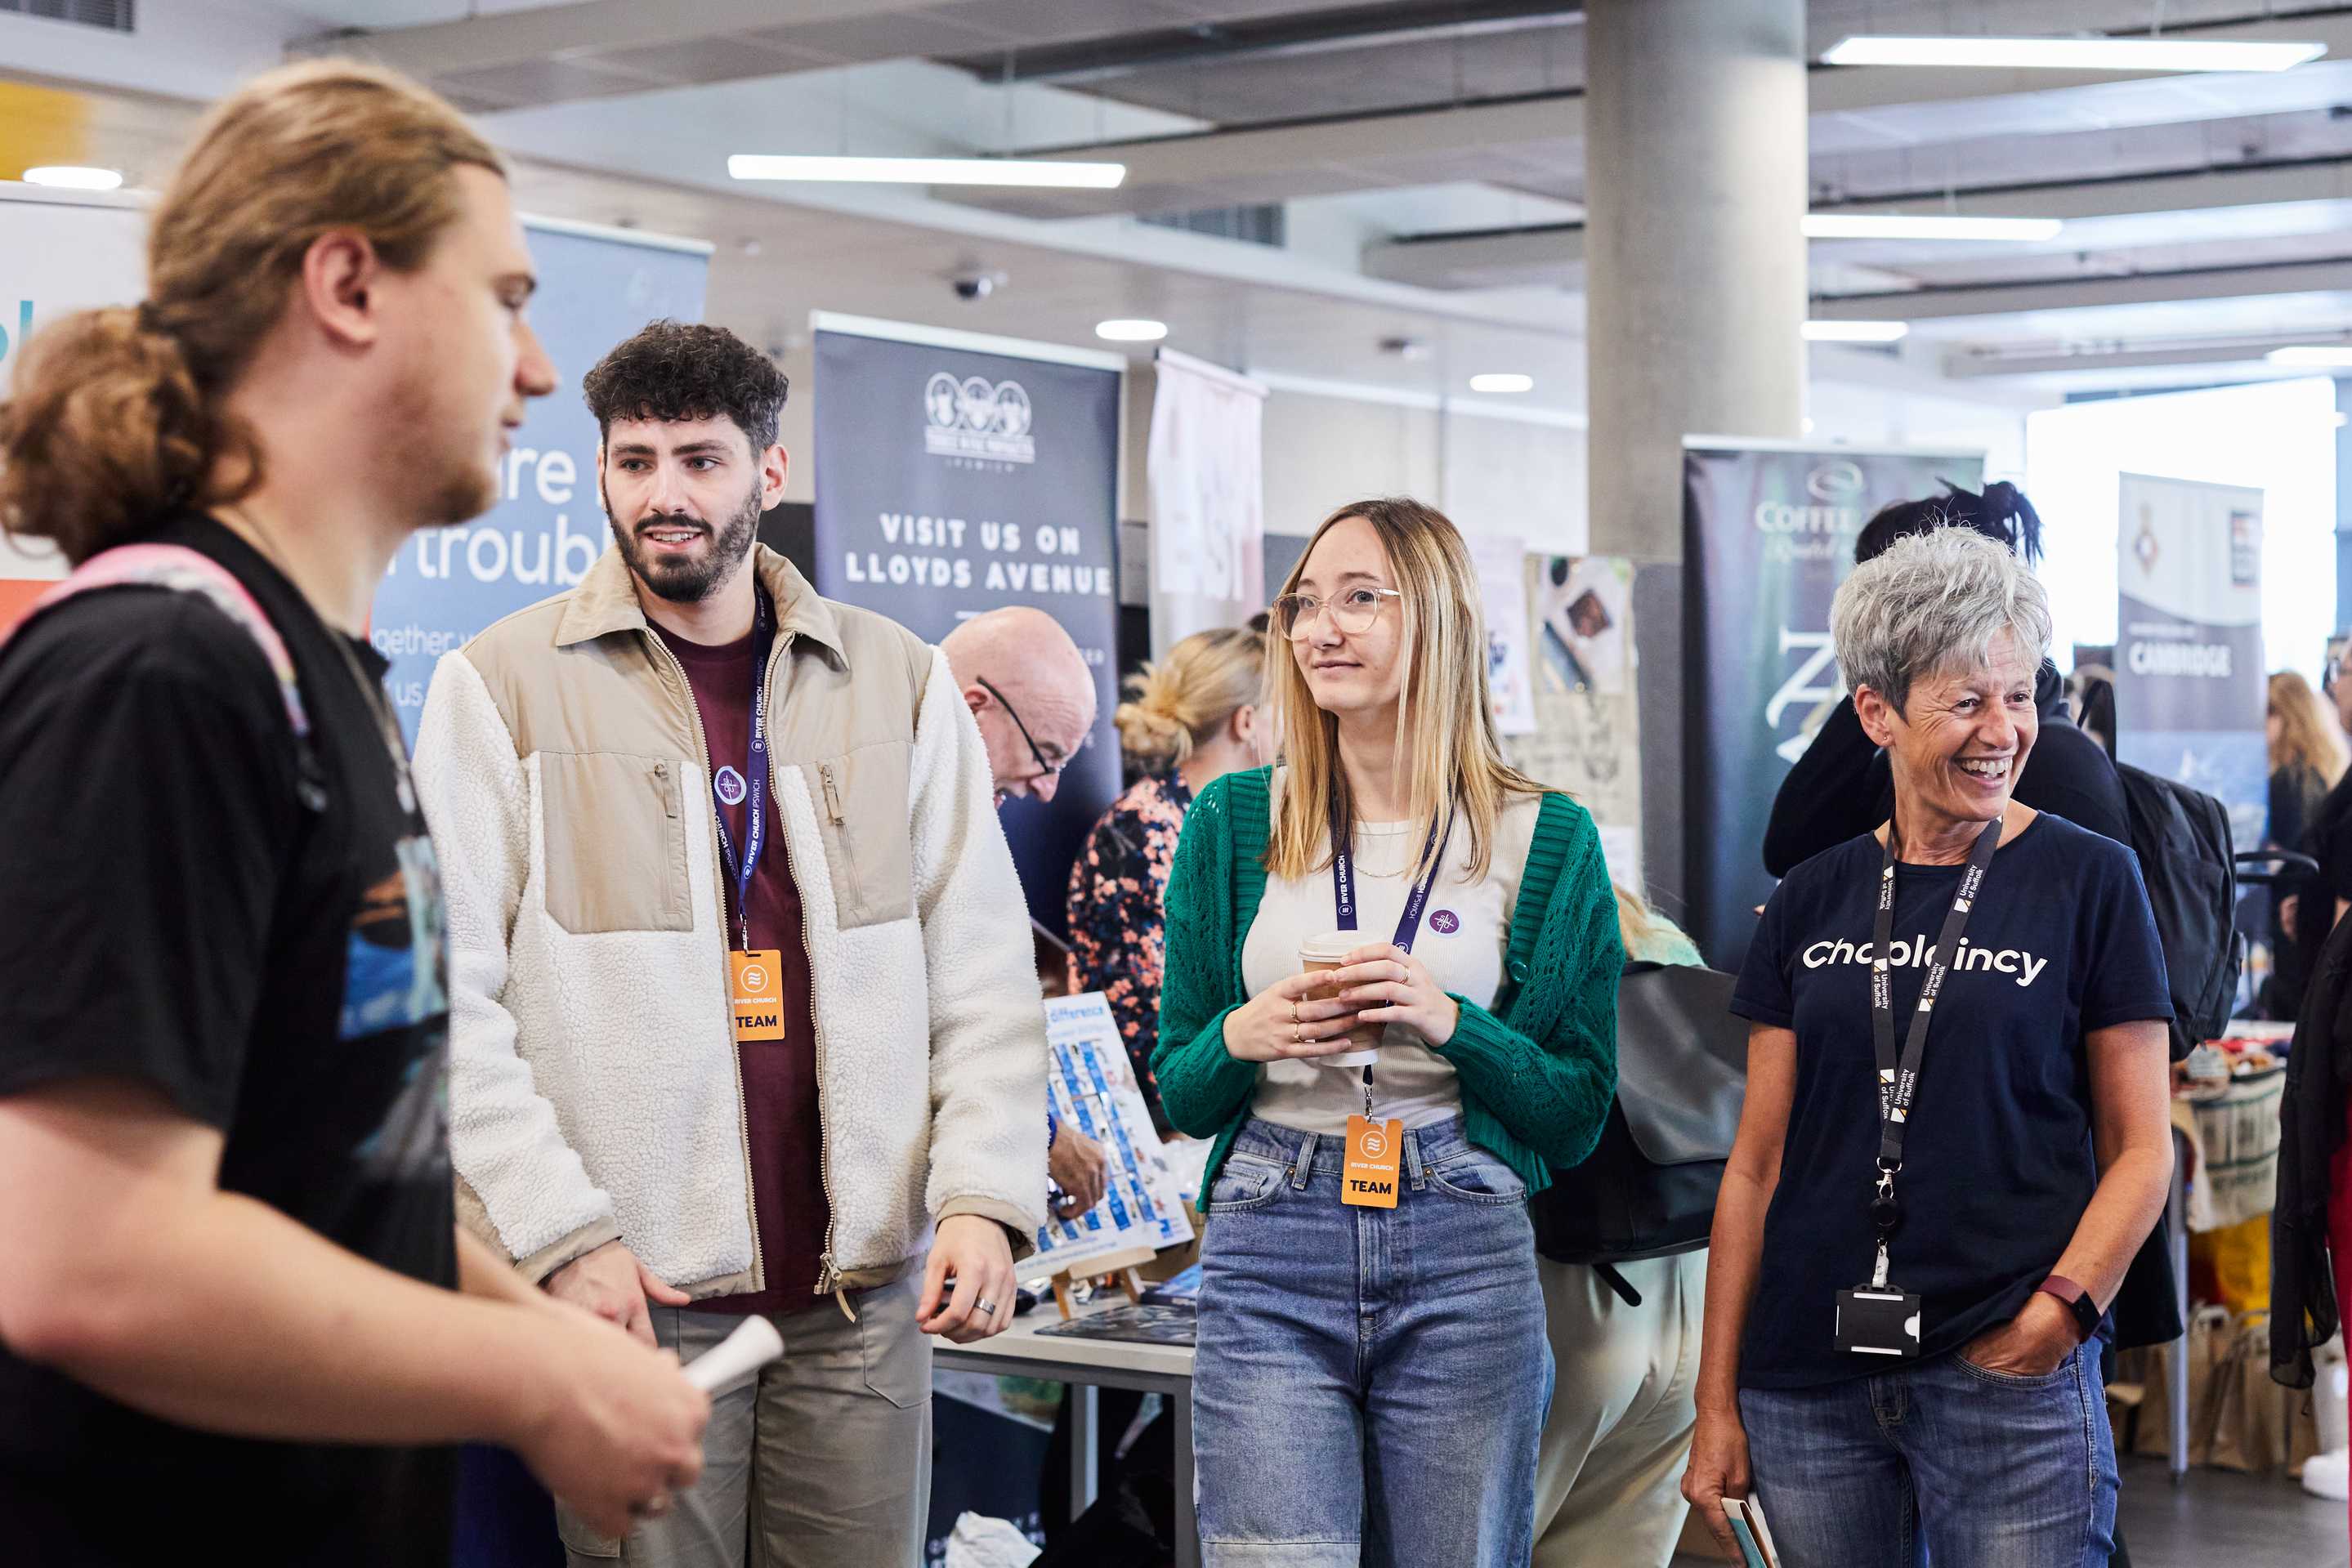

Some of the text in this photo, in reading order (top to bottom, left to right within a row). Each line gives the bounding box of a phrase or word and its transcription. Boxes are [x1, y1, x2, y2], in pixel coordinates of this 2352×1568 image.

[497, 446, 577, 505] re
[879, 513, 1080, 556] VISIT US ON
[845, 552, 1111, 596] LLOYDS AVENUE
[756, 686, 764, 716] CHURCH
[755, 717, 763, 739] RIVER
[748, 779, 761, 865] RIVER CHURCH IPSWICH
[1339, 855, 1347, 883] CHURCH
[1960, 864, 1978, 896] University
[1970, 869, 1983, 891] Suffolk
[1408, 894, 1423, 919] IPSWICH
[1881, 974, 1889, 1009] University
[1923, 963, 1940, 995] University
[1933, 966, 1946, 988] Suffolk
[1874, 982, 1882, 1007] Suffolk
[736, 1015, 777, 1028] TEAM
[1894, 1069, 1909, 1104] University
[1904, 1073, 1915, 1097] Suffolk
[1350, 1179, 1392, 1195] TEAM
